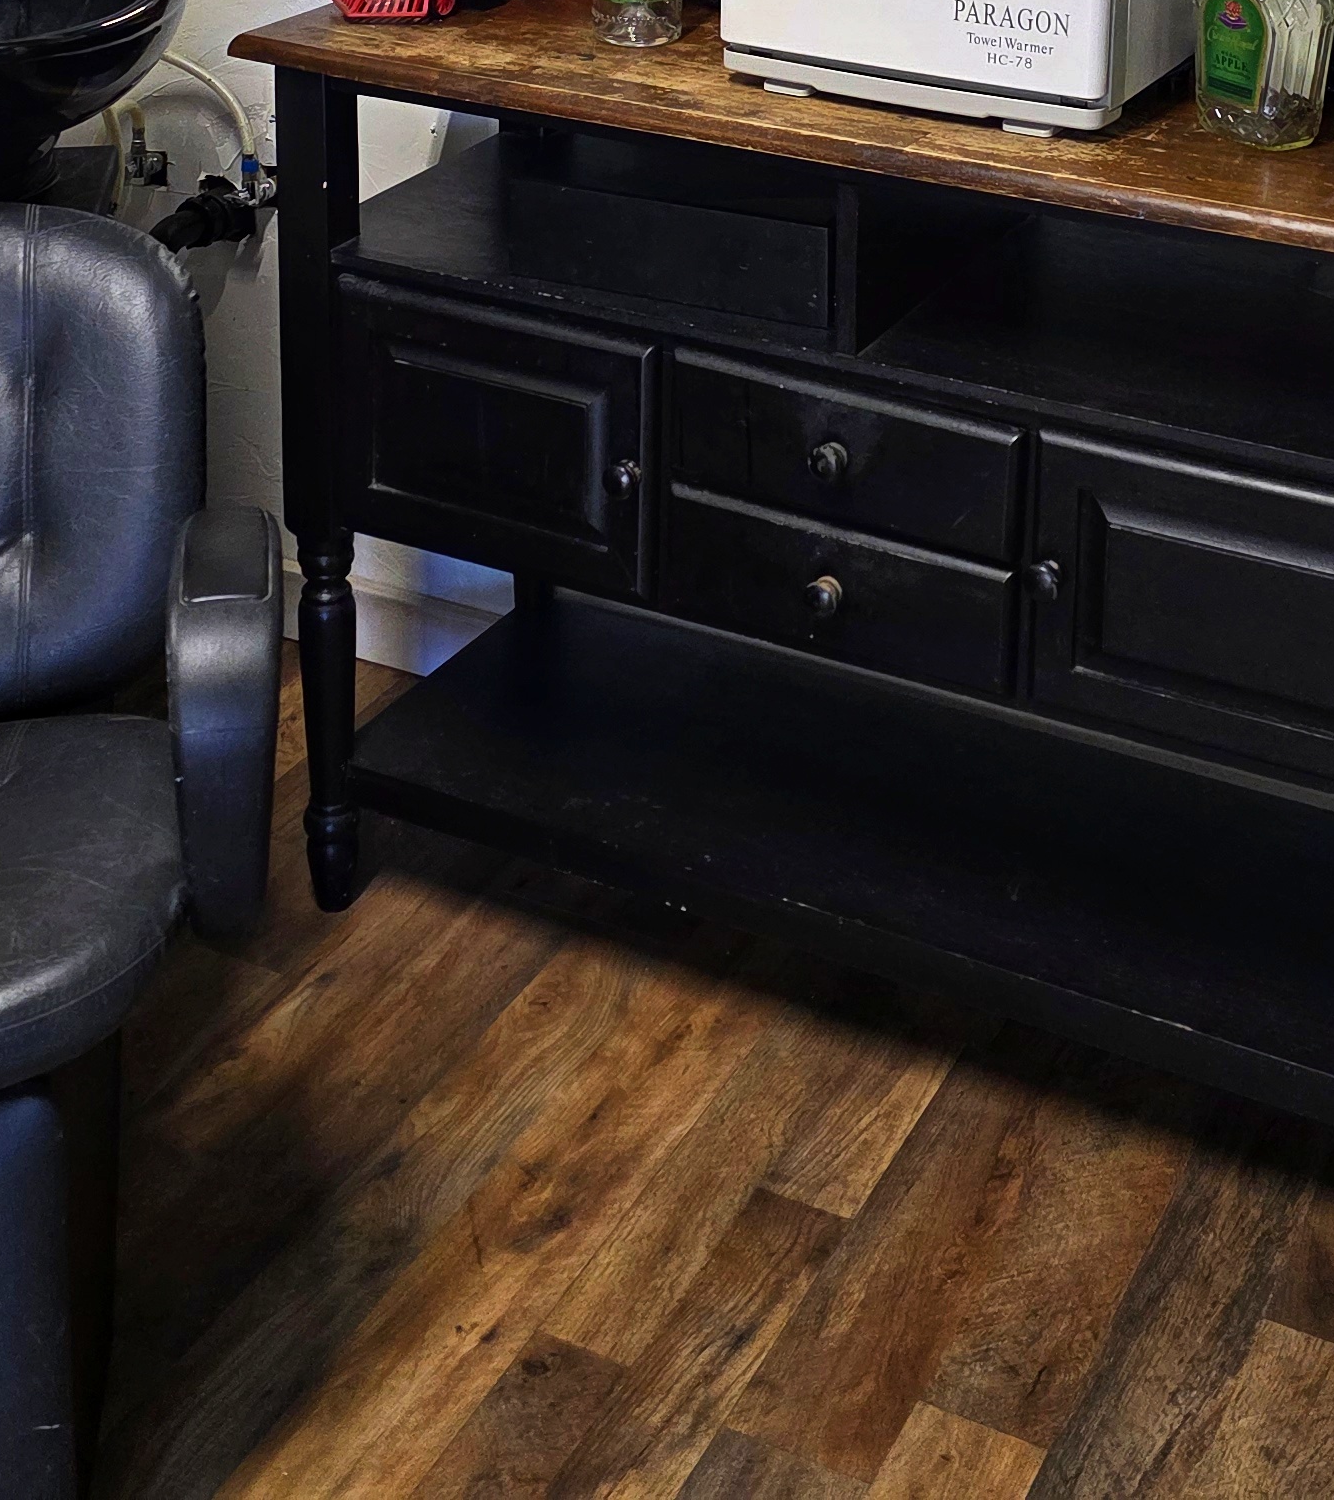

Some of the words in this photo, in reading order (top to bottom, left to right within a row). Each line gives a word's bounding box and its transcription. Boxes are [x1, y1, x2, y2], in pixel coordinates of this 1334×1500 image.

[954, 0, 1070, 38] PARAGON
[967, 31, 1002, 48] Towel
[1005, 37, 1054, 55] Warmer
[987, 52, 1032, 69] HC-78
[1215, 53, 1249, 72] APPLE
